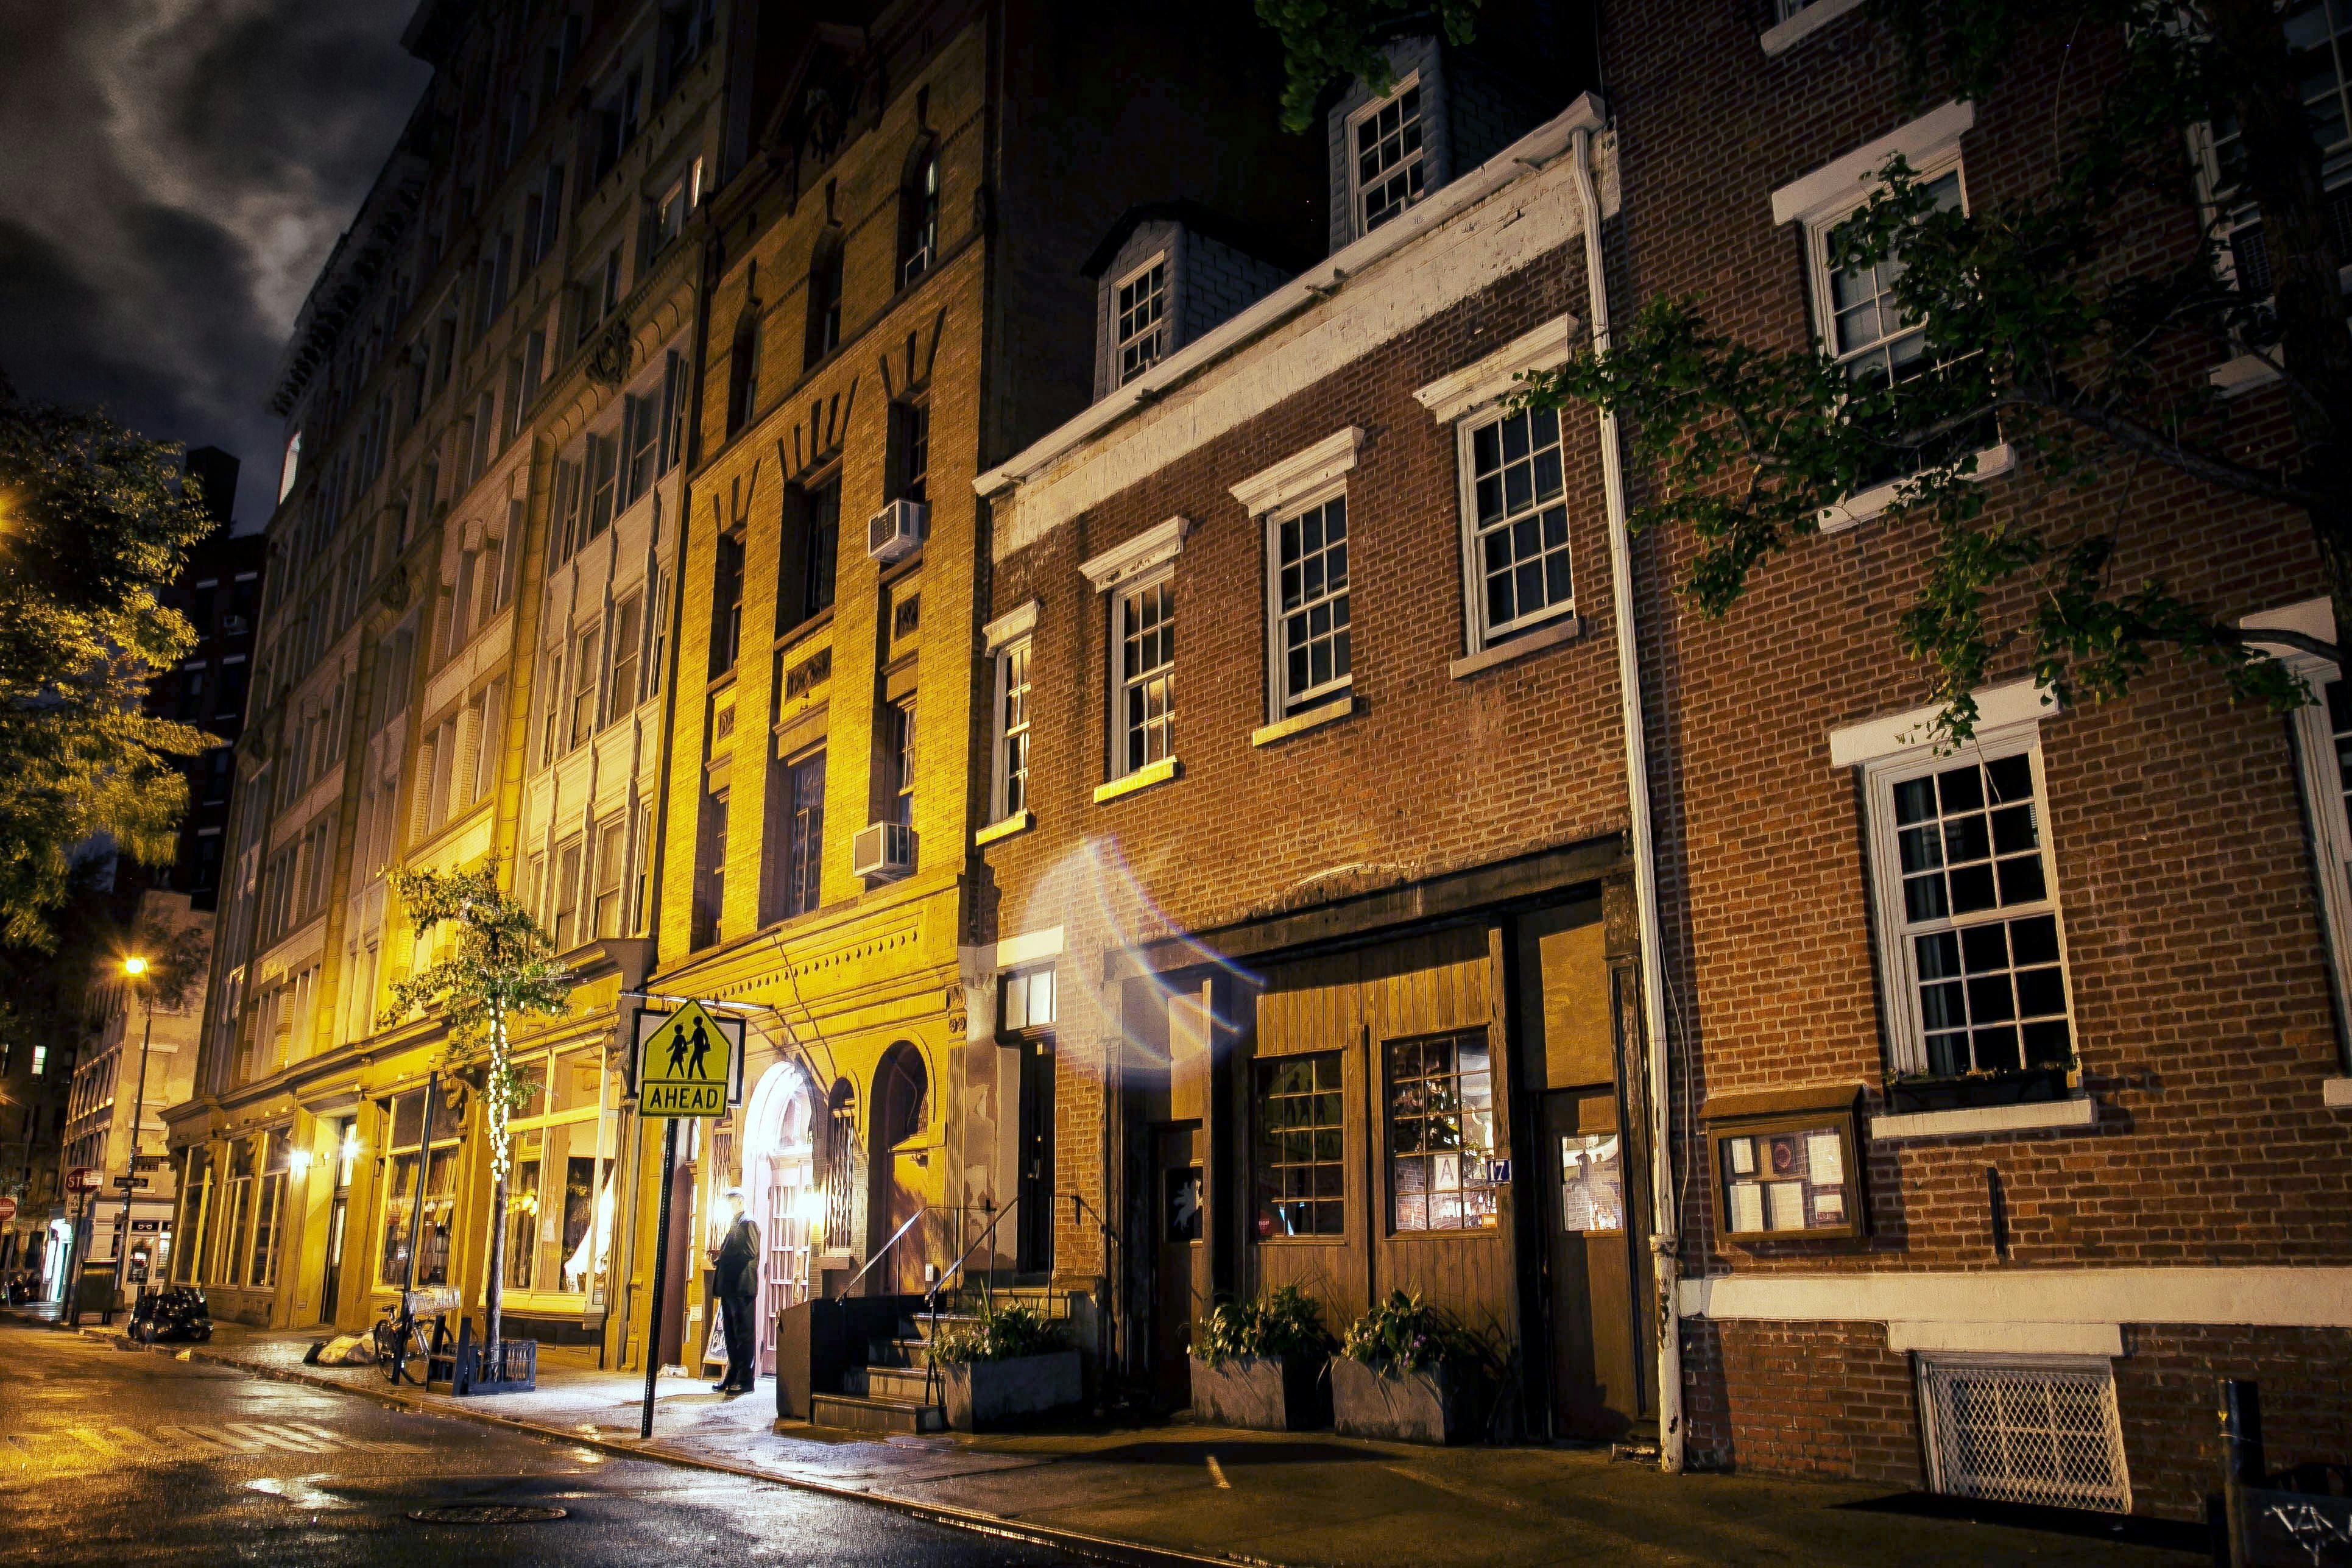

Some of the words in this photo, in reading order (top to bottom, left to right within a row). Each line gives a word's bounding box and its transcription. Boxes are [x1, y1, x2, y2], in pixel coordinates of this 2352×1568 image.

[649, 1087, 718, 1109] AHEAD
[1440, 1158, 1454, 1182] A
[1489, 1160, 1505, 1181] 17
[68, 1176, 82, 1188] ST
